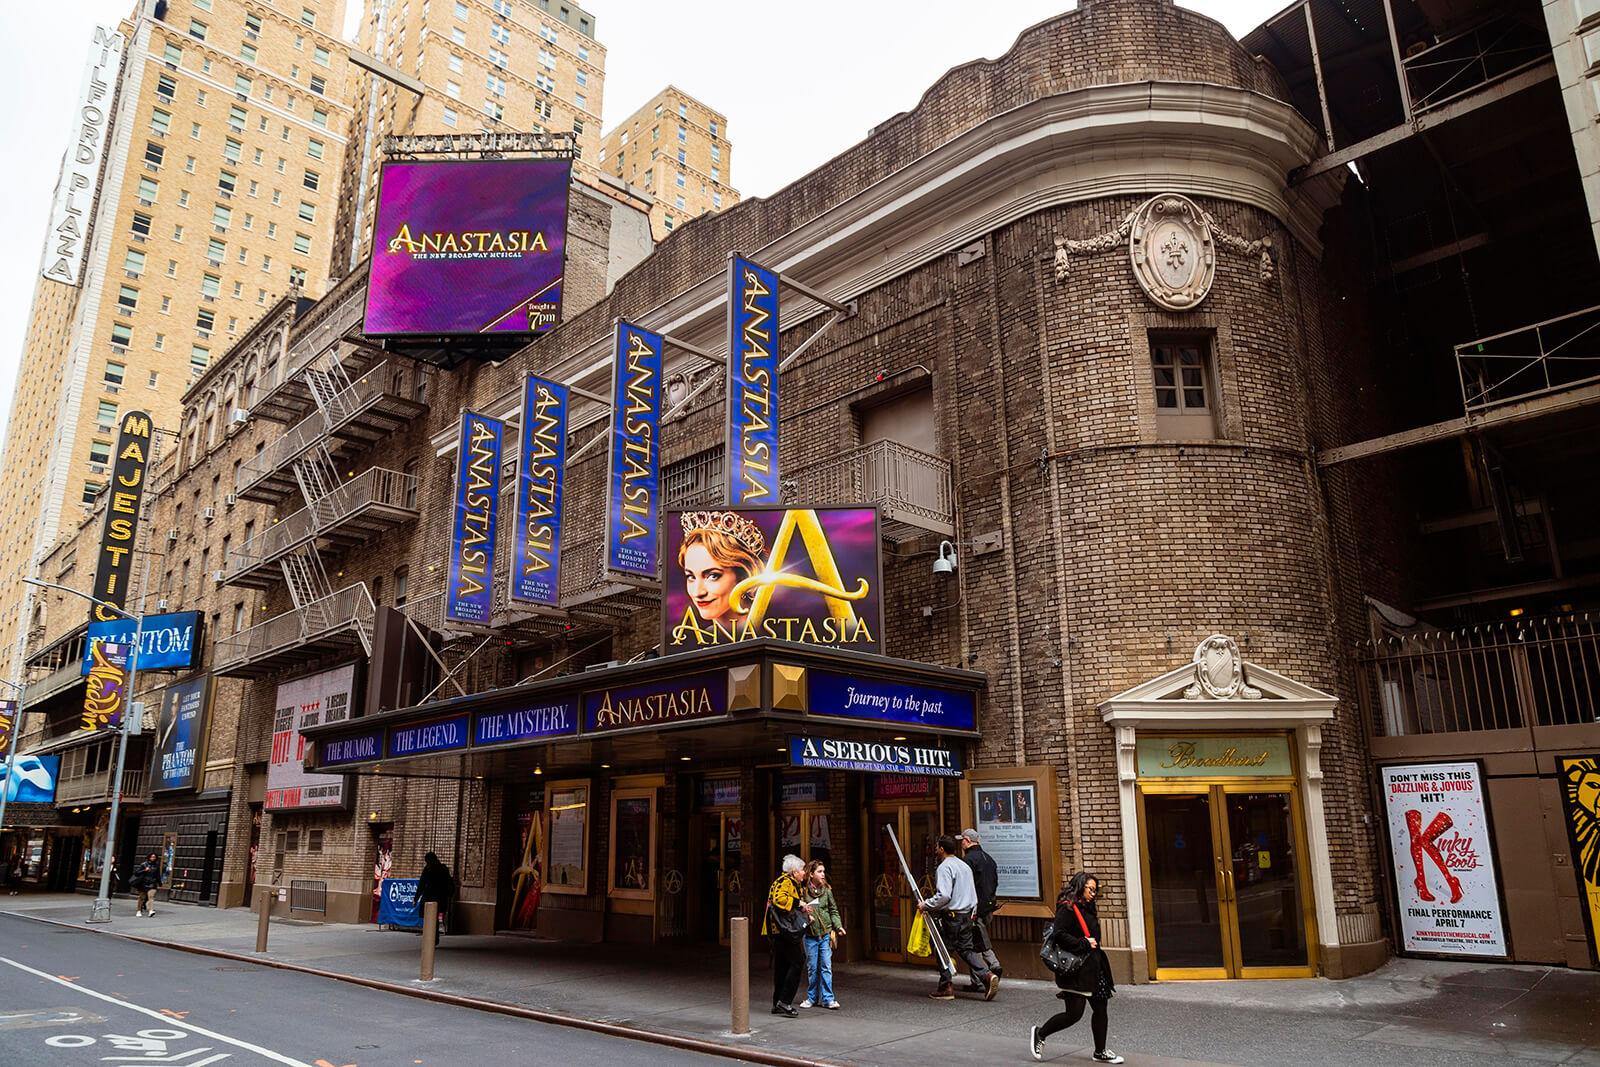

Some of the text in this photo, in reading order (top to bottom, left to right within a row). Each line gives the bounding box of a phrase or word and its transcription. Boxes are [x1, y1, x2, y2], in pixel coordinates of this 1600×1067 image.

[76, 26, 120, 165] MILFORD
[48, 173, 89, 281] PLAZA
[388, 224, 548, 253] ANASTASIA
[528, 311, 556, 330] 7pm
[743, 267, 770, 502] ANASTASIA
[621, 332, 655, 543] ANASTASIA
[525, 384, 560, 575] ANASTASIA
[95, 415, 149, 622] MAJESTIC
[459, 420, 495, 597] ANASTASIA
[617, 553, 649, 565] BROADWAY
[621, 547, 648, 558] THE NEW
[621, 560, 647, 570] MUSICAL
[521, 585, 551, 596] BROADWAY
[524, 579, 550, 590] THE NEW
[523, 591, 548, 601] MUSICAL
[454, 606, 484, 616] BROADWAY
[457, 612, 481, 620] MUSICAL
[669, 605, 876, 646] ANASTASIA
[87, 625, 192, 662] PNTOM
[596, 687, 713, 727] ANASTASIA
[844, 686, 945, 717] Journey to the past.
[480, 704, 569, 739] THE MYSTERY.
[395, 723, 459, 752] THE LEGEND.
[162, 748, 197, 771] PHANTOM
[327, 741, 342, 761] THE
[343, 737, 376, 760] RUMOR.
[822, 739, 910, 765] SERIOUS
[914, 747, 952, 767] HIT!
[1160, 742, 1270, 769] Broadhurst
[803, 757, 837, 769] BROADWAY'S
[837, 760, 849, 769] GOT
[849, 761, 854, 769] A
[854, 761, 873, 771] BRIGHT
[873, 762, 886, 772] NEW
[886, 763, 899, 773] STAR
[1390, 771, 1471, 783] DON'T MISS THIS
[1431, 782, 1439, 792] &
[1420, 793, 1445, 803] HIT!
[1445, 853, 1484, 869] Boots
[398, 882, 418, 893] The Shub
[1407, 908, 1493, 920] FINAL PERFORMANCE
[1435, 918, 1465, 928] APRIL 7
[1416, 930, 1490, 940] KINKYBOOTSTHEMUSICAL.COM
